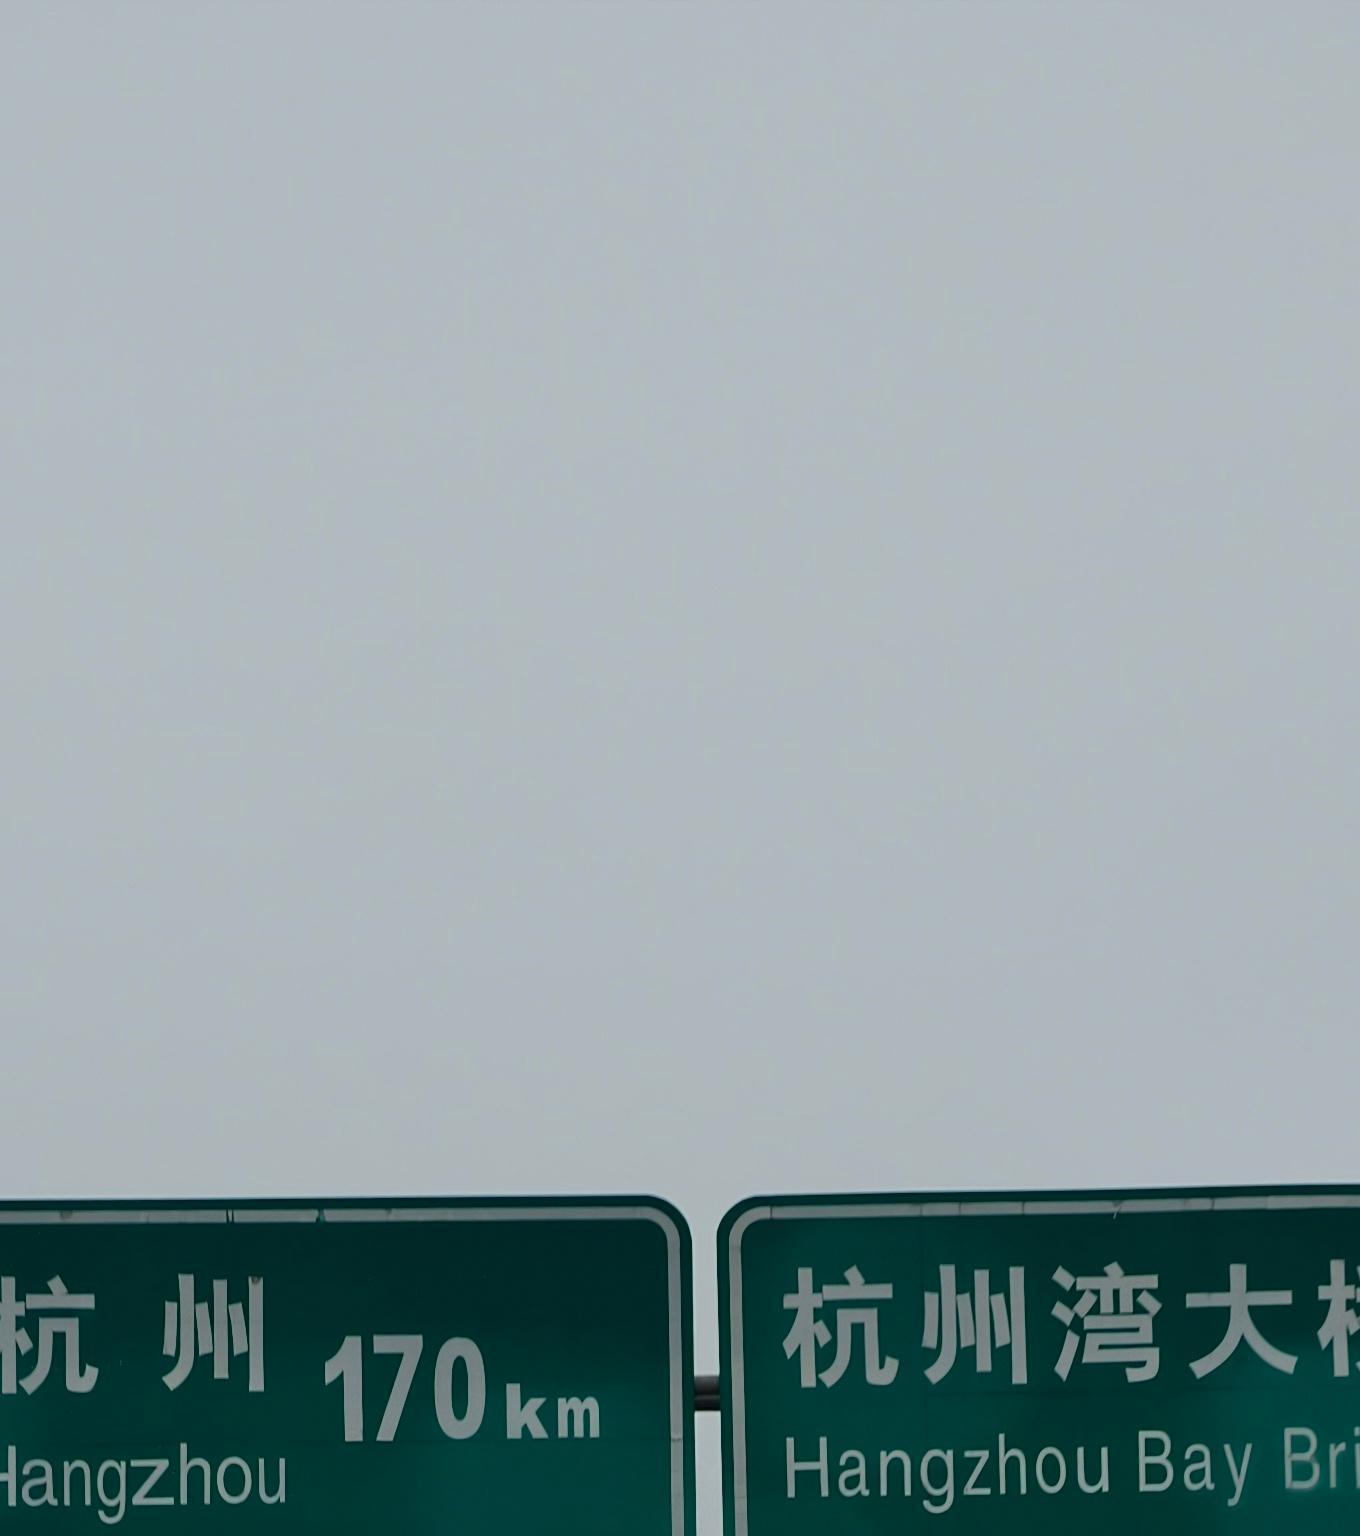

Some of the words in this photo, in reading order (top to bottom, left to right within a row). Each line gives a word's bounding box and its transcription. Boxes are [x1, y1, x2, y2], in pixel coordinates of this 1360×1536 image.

[325, 1334, 486, 1442] 170
[505, 1384, 601, 1439] km
[785, 1433, 1110, 1514] Hangzhou
[1138, 1430, 1253, 1507] Bay
